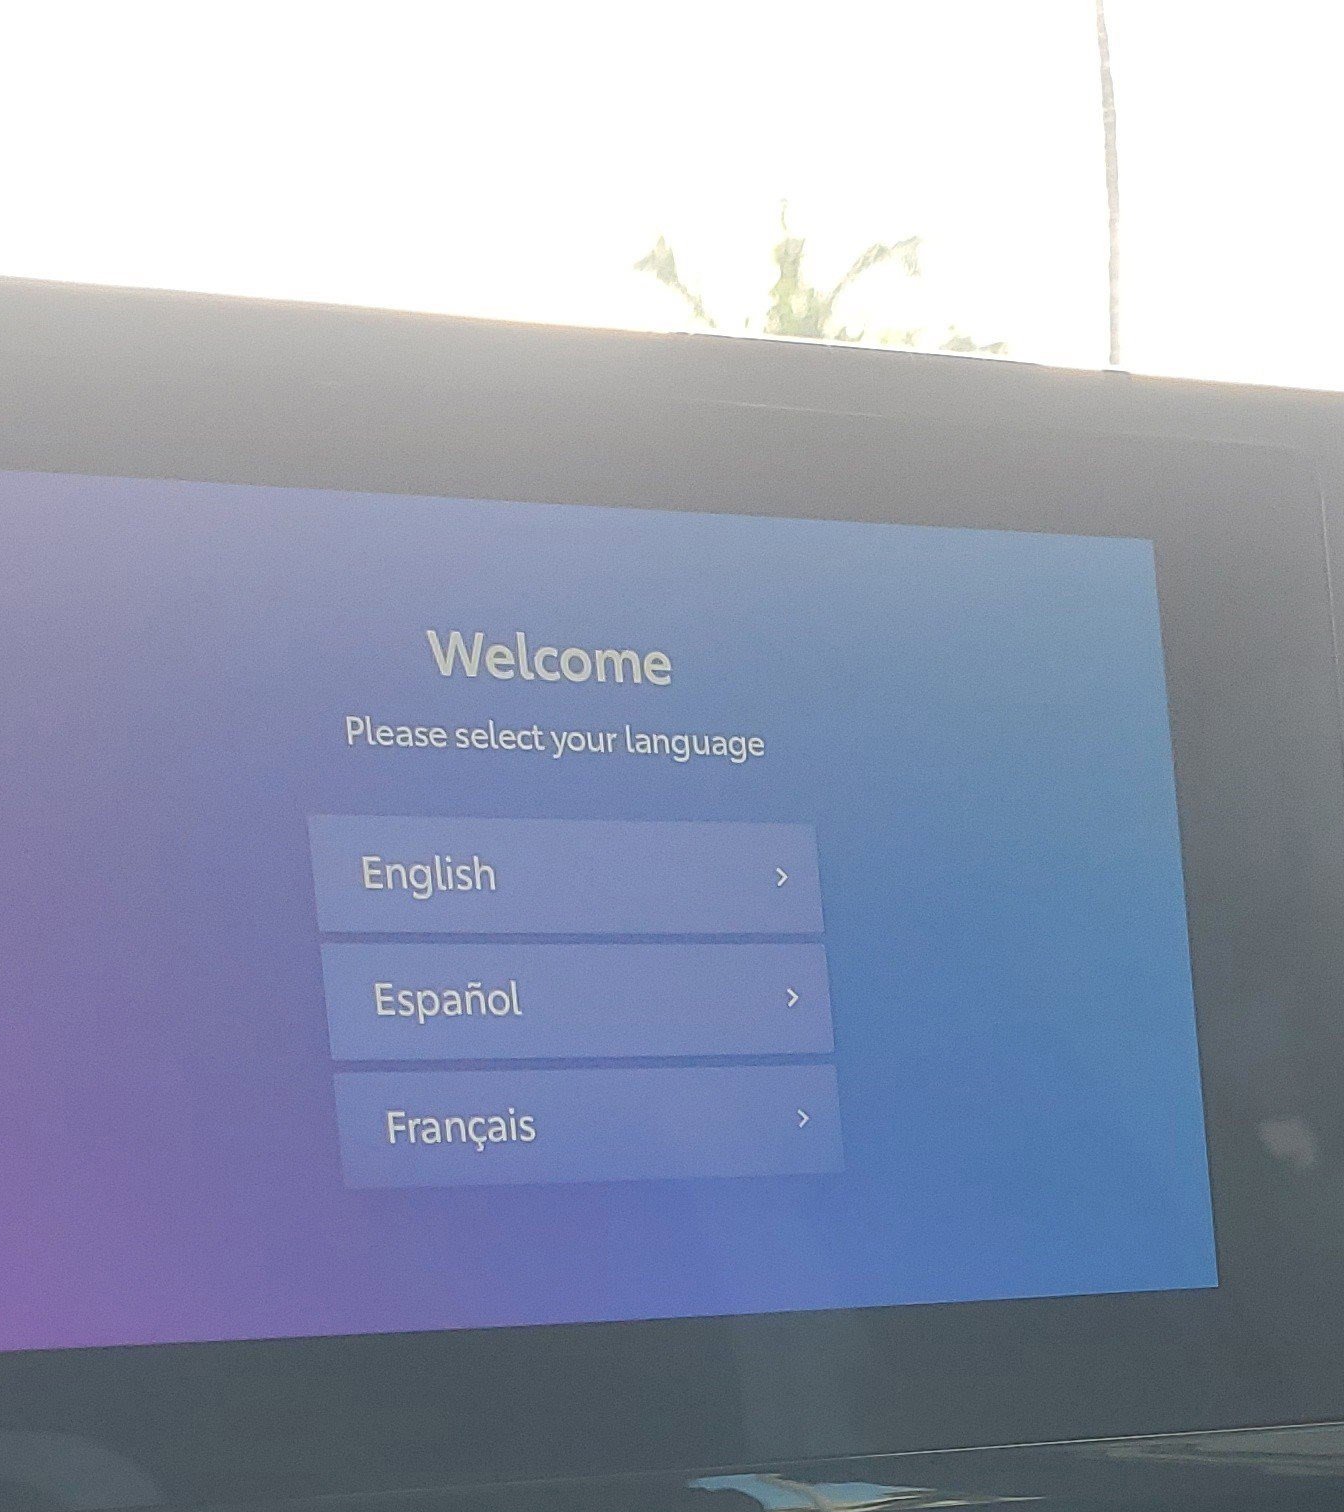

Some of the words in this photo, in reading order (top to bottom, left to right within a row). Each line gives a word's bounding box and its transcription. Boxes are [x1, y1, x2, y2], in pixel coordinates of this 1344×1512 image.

[426, 629, 672, 685] Welcome
[346, 715, 448, 748] Please
[455, 719, 544, 752] select
[551, 731, 617, 759] your
[625, 726, 765, 764] language
[361, 855, 497, 899] English
[374, 980, 522, 1024] Español
[386, 1108, 536, 1151] Français
